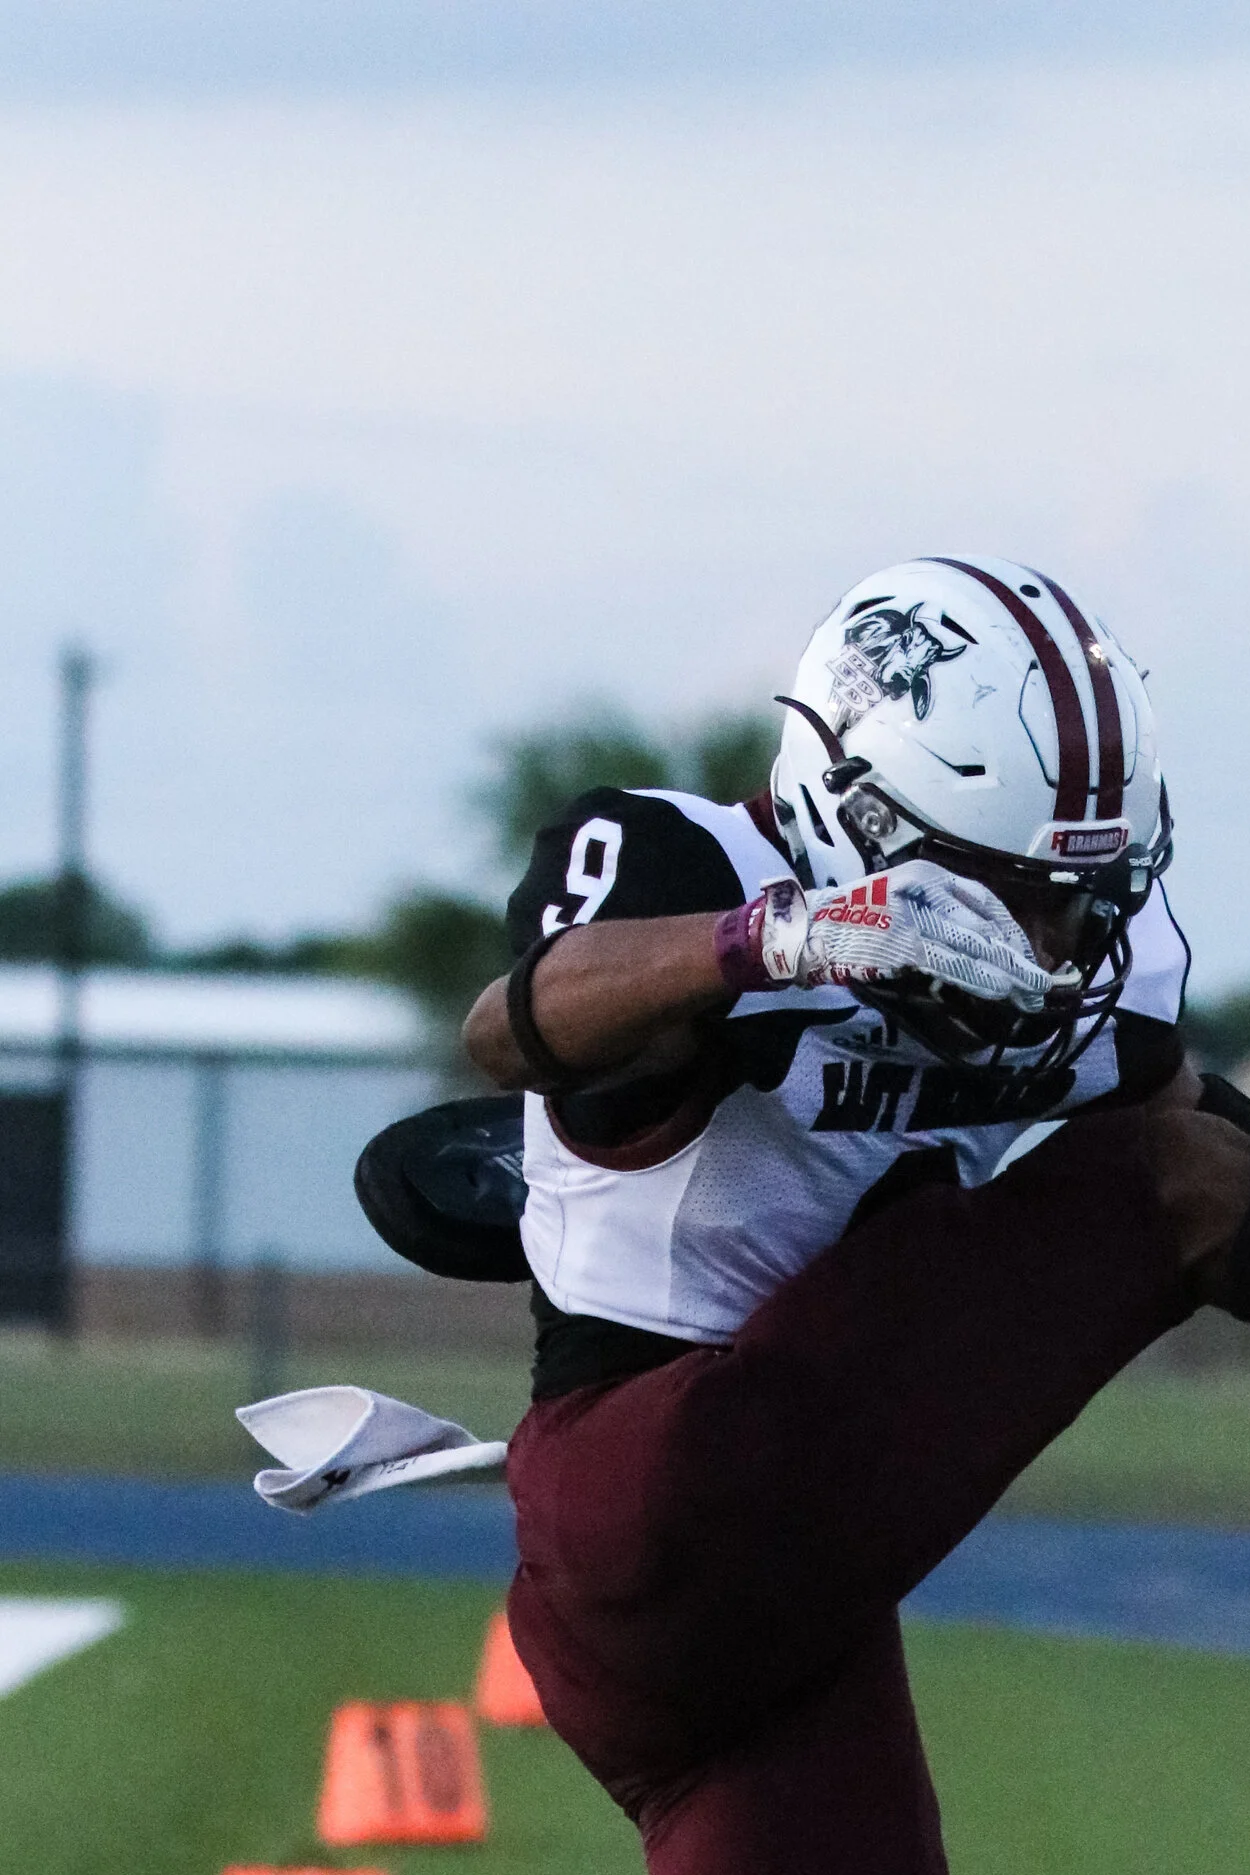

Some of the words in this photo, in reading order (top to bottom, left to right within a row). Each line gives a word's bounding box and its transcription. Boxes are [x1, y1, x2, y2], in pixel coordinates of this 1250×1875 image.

[1067, 832, 1120, 853] BRAHMAS
[541, 817, 623, 938] 9
[813, 905, 892, 930] adidas
[369, 1718, 463, 1814] 10
